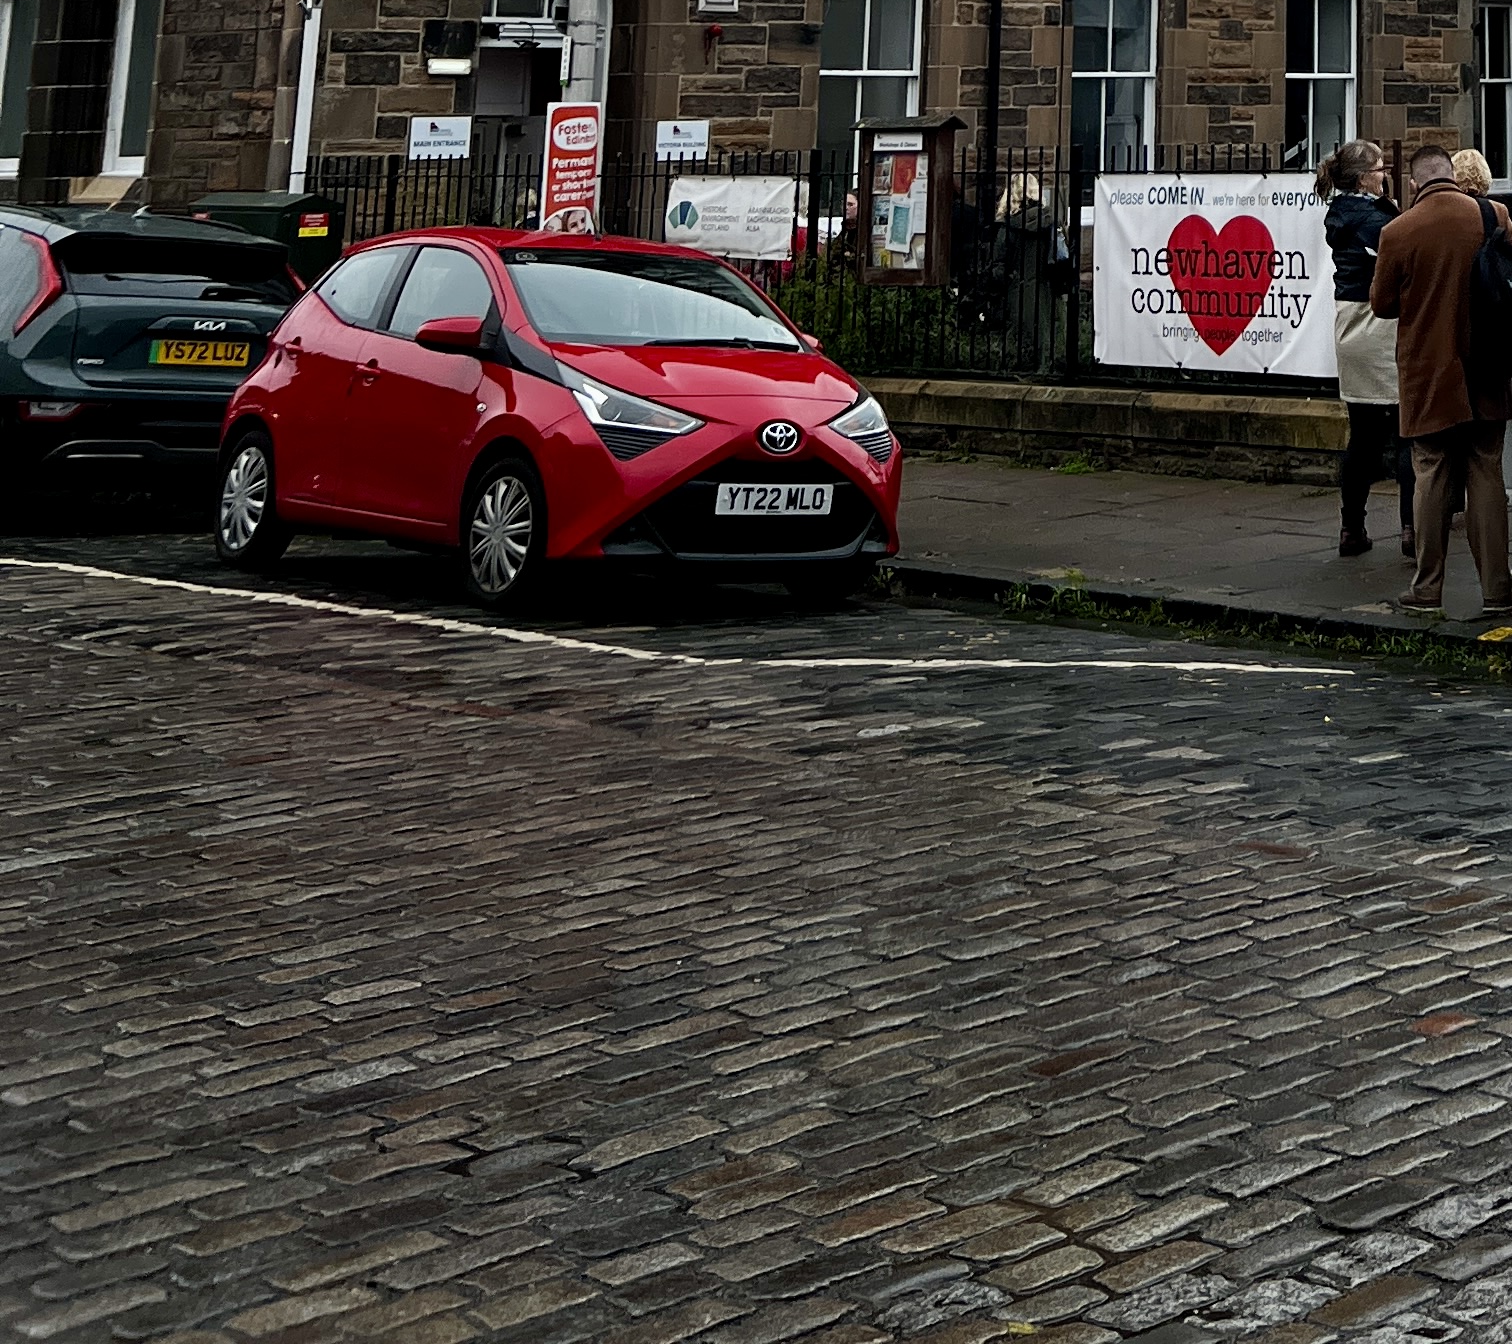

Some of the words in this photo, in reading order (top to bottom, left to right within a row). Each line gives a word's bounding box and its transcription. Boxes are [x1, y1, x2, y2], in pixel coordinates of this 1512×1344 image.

[1109, 189, 1145, 208] please
[1148, 186, 1188, 205] COME
[1212, 192, 1234, 206] we're
[1235, 193, 1256, 207] here
[1258, 192, 1271, 206] for
[701, 223, 730, 232] SCOTLAND
[1131, 240, 1310, 280] newhaven
[1131, 285, 1312, 329] community
[1162, 323, 1200, 343] bringing
[1202, 327, 1237, 344] people
[1241, 327, 1284, 346] together
[164, 342, 208, 361] YS72
[212, 343, 248, 362] LUZ
[728, 487, 782, 510] YT22
[785, 487, 825, 510] MLO
